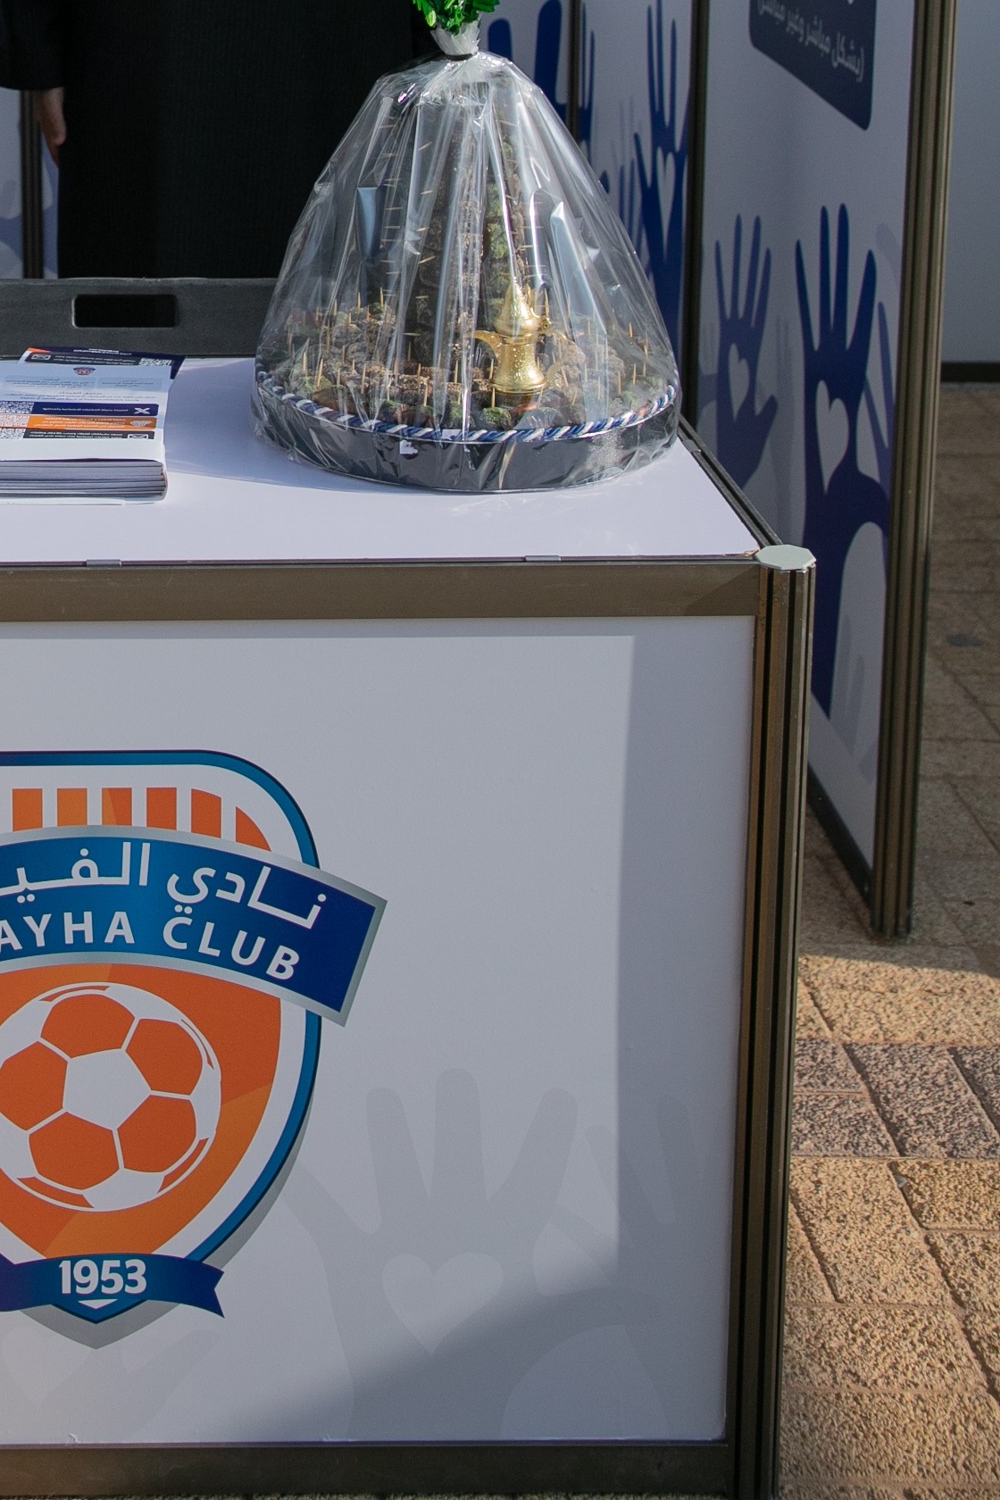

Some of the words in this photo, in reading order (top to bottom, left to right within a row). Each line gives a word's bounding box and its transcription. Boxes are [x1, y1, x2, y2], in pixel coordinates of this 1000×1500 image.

[166, 861, 327, 930] نادي
[162, 916, 301, 981] CLUB
[58, 1258, 148, 1296] 1953
